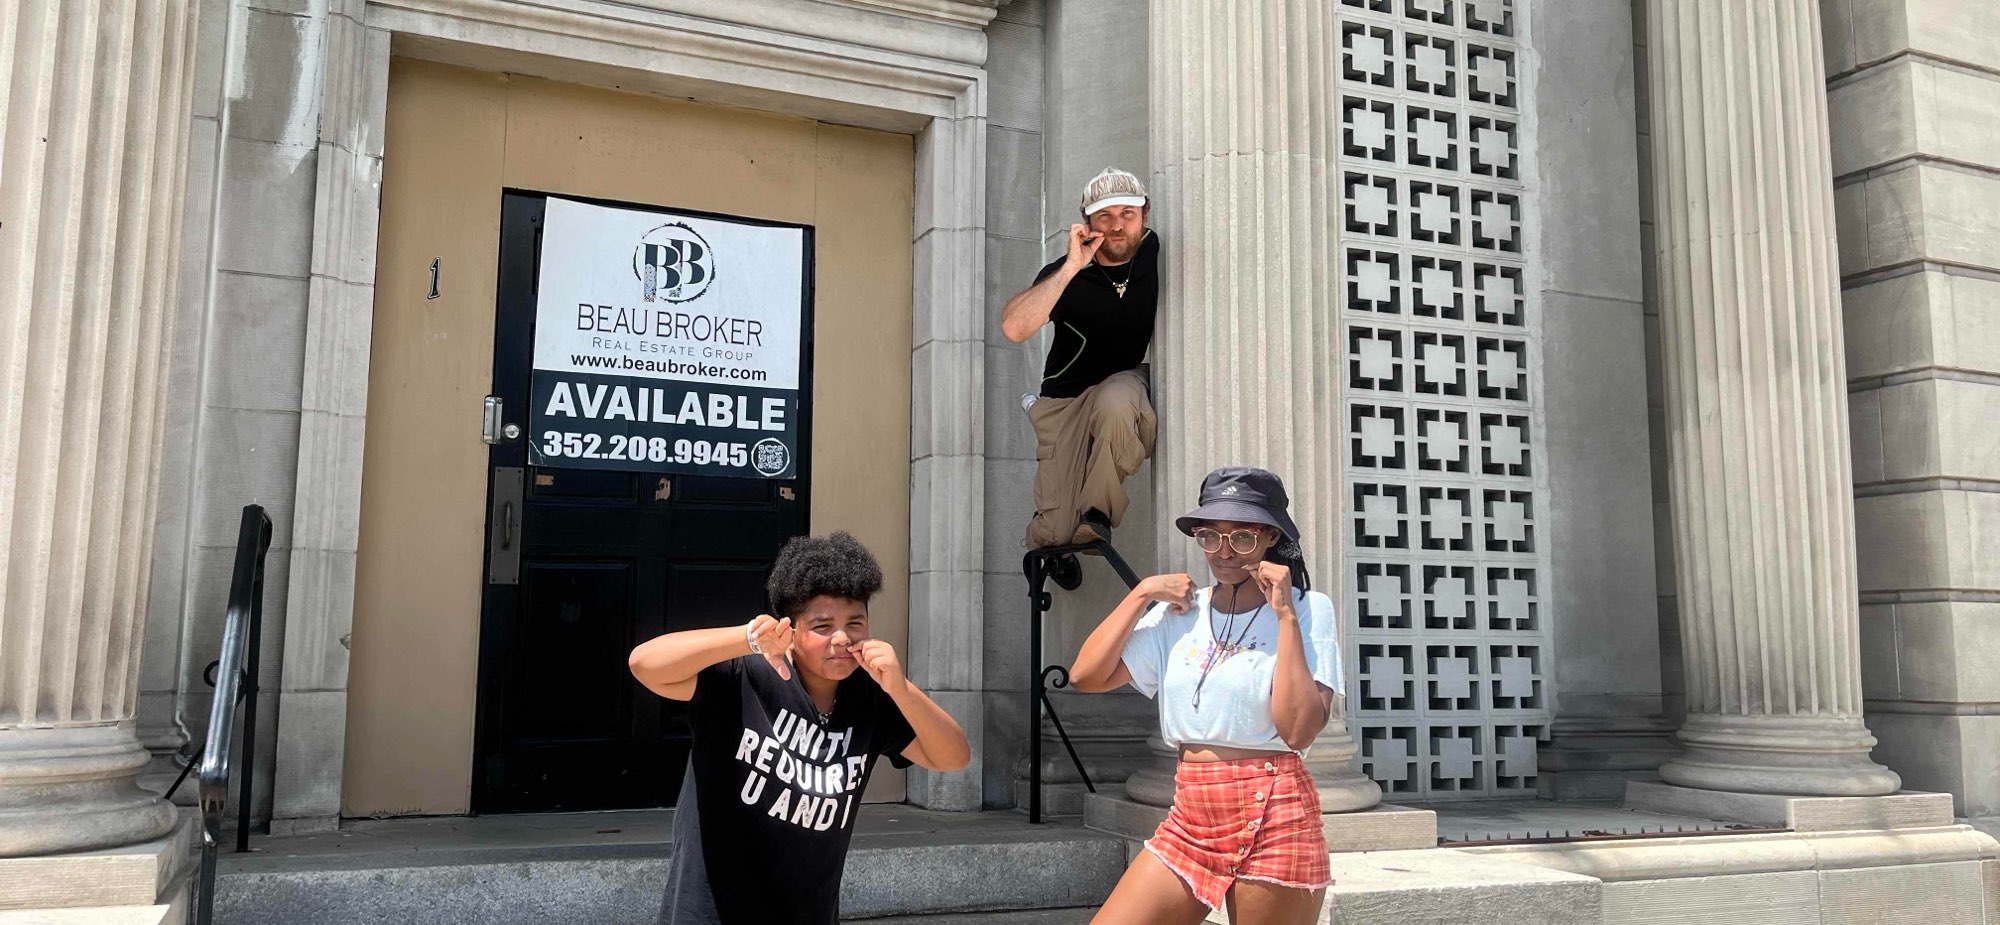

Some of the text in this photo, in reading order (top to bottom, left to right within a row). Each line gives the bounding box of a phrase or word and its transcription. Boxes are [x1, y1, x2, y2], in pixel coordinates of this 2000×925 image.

[427, 257, 441, 300] 1
[577, 303, 762, 347] BEAU BROKER
[571, 354, 767, 381] www.beaubroker.com
[545, 381, 786, 432] AVAILABLE
[543, 430, 748, 467] 352.208.9945
[741, 769, 853, 831] U AND I
